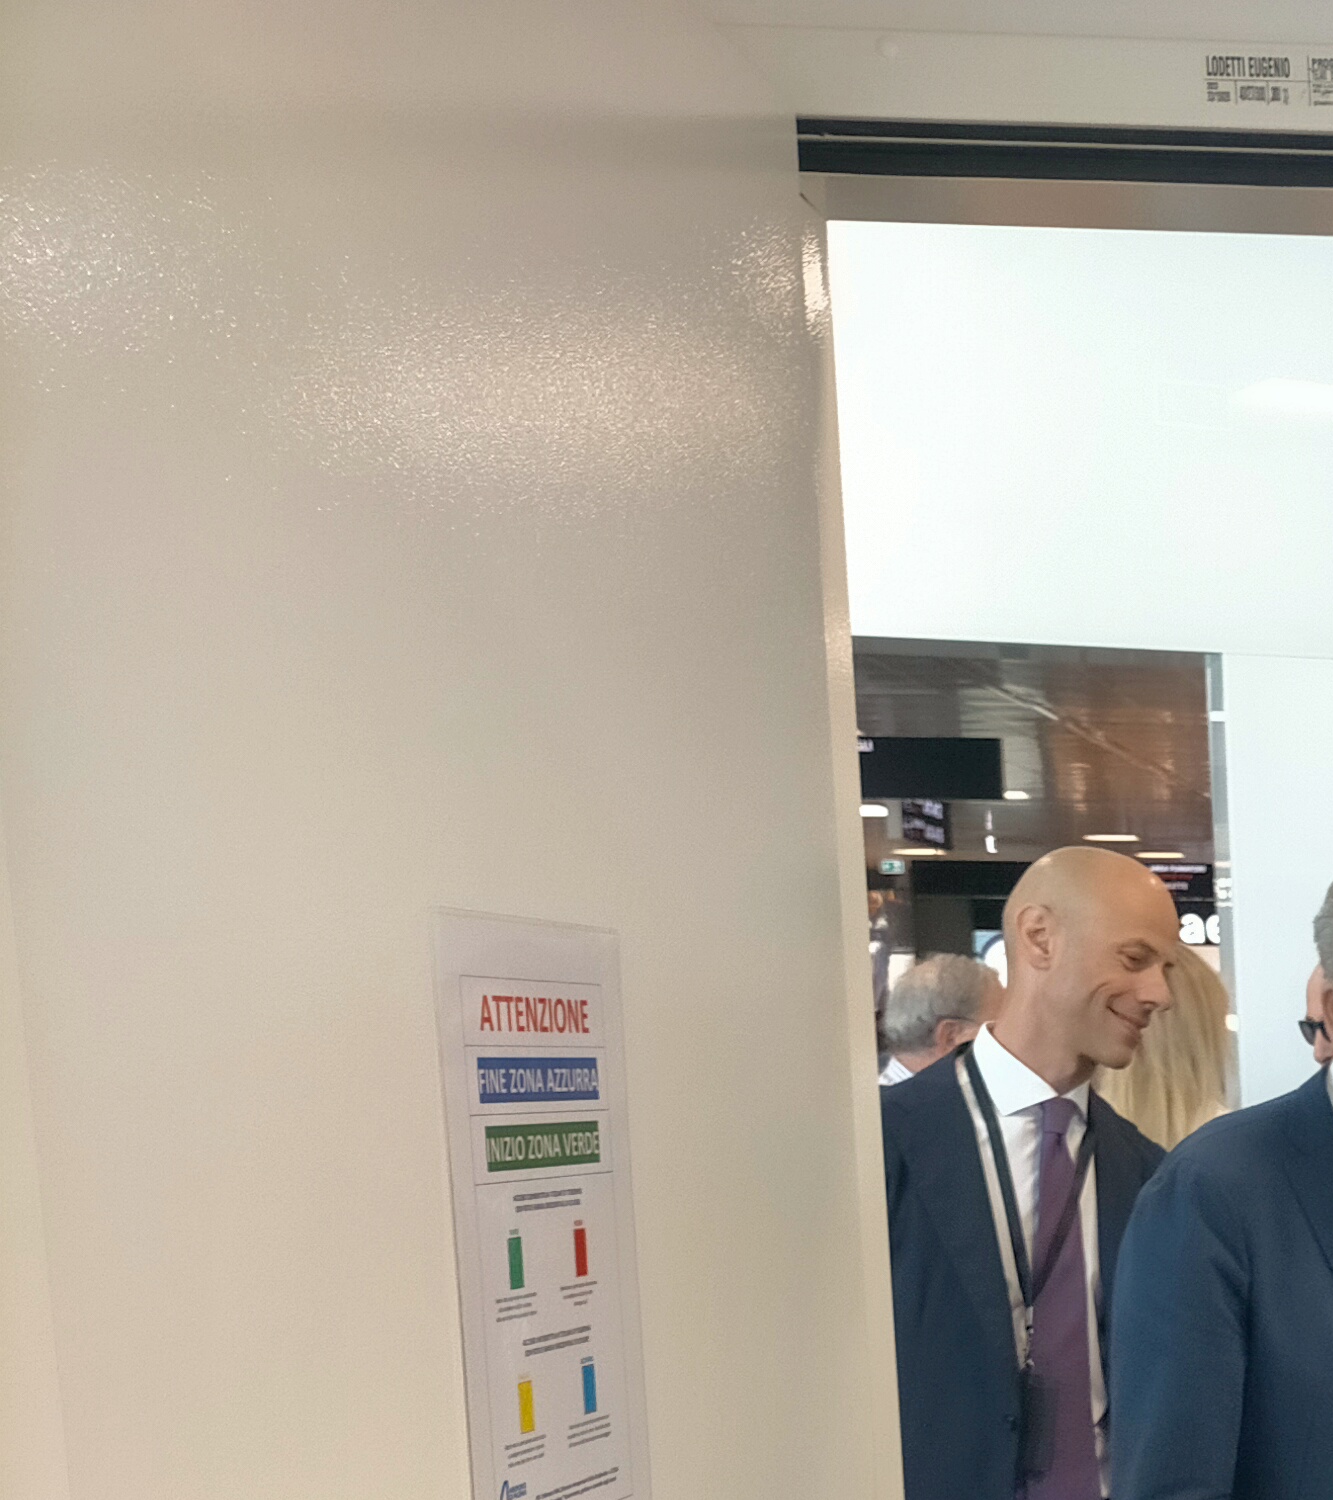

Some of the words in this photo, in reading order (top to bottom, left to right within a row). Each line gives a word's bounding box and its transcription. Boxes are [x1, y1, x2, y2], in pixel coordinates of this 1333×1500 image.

[1205, 55, 1246, 77] LODETTI
[1248, 56, 1291, 78] EUGENIO
[480, 994, 590, 1034] ATTENZIONE
[478, 1068, 507, 1094] FINE
[509, 1068, 545, 1094] ZONA
[547, 1068, 599, 1093] AZZURRA
[486, 1135, 525, 1163] INIZIO
[527, 1133, 562, 1160] ZONA
[562, 1131, 600, 1156] VERDE
